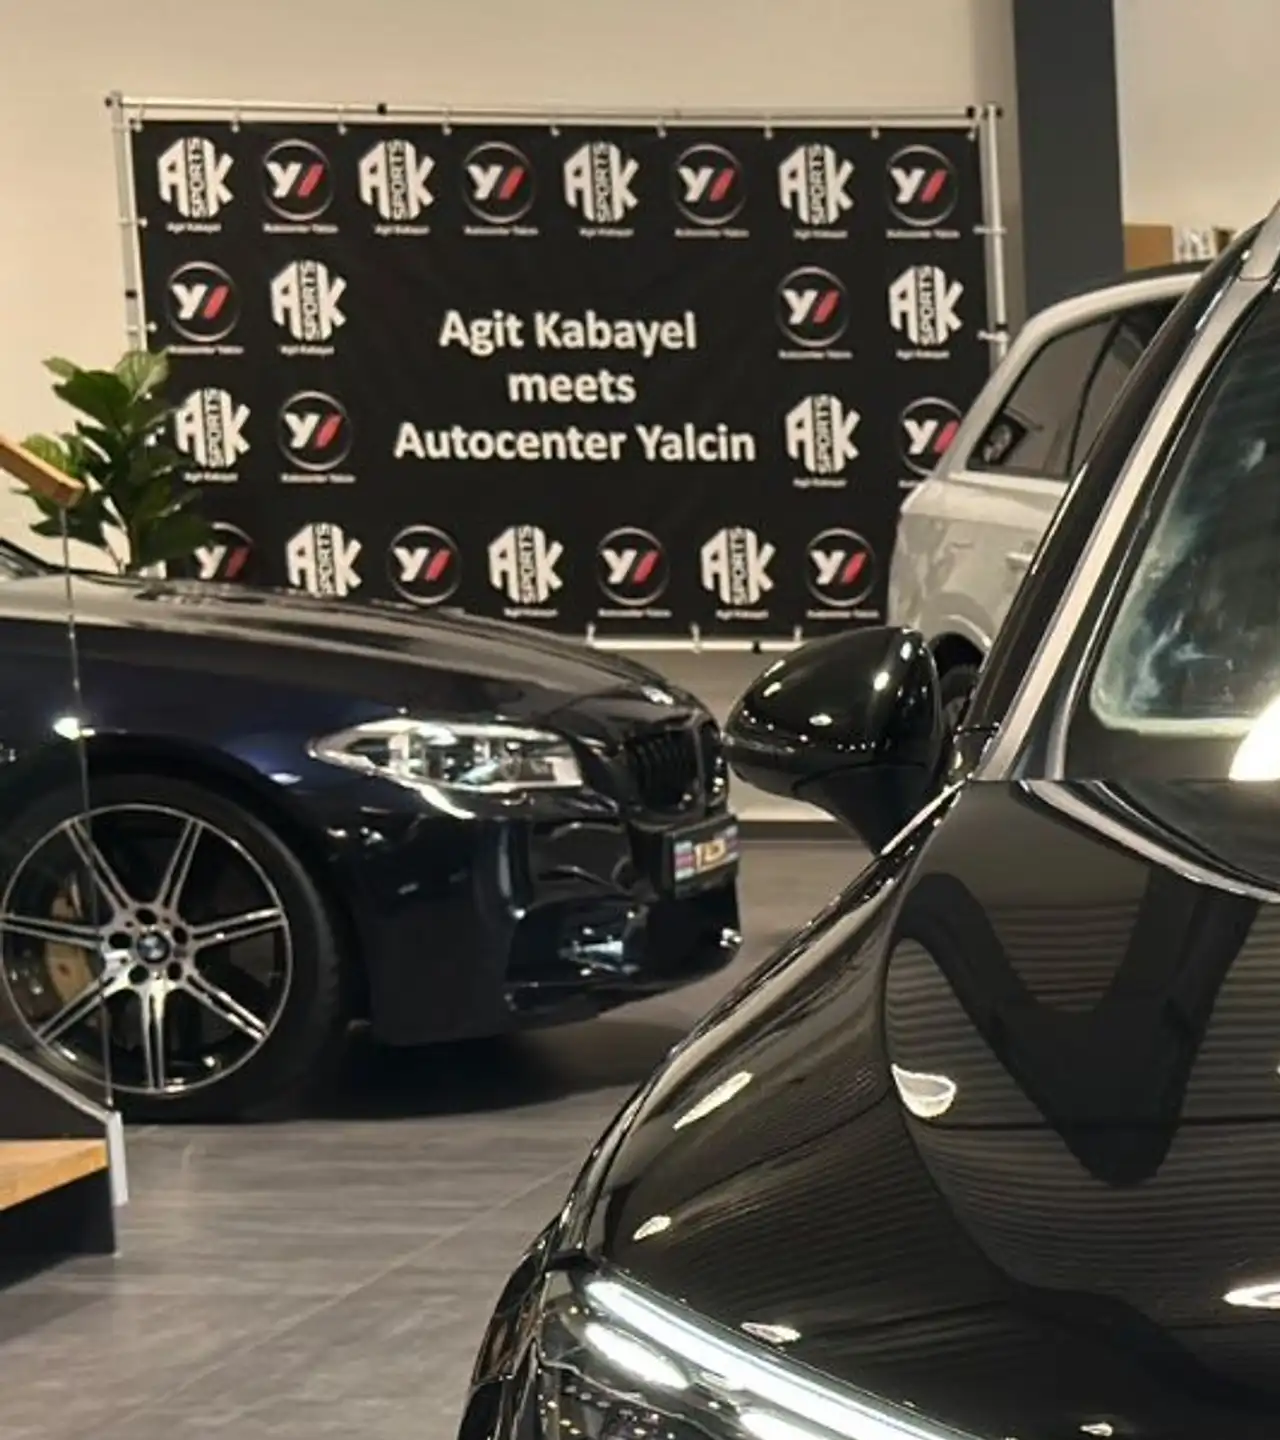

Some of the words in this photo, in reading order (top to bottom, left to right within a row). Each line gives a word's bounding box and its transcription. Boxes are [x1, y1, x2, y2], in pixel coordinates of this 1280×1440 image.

[439, 309, 525, 356] Agit
[534, 310, 697, 358] Kabayel
[508, 370, 637, 403] meets
[394, 421, 627, 461] Autocenter
[635, 423, 756, 462] Yalcin
